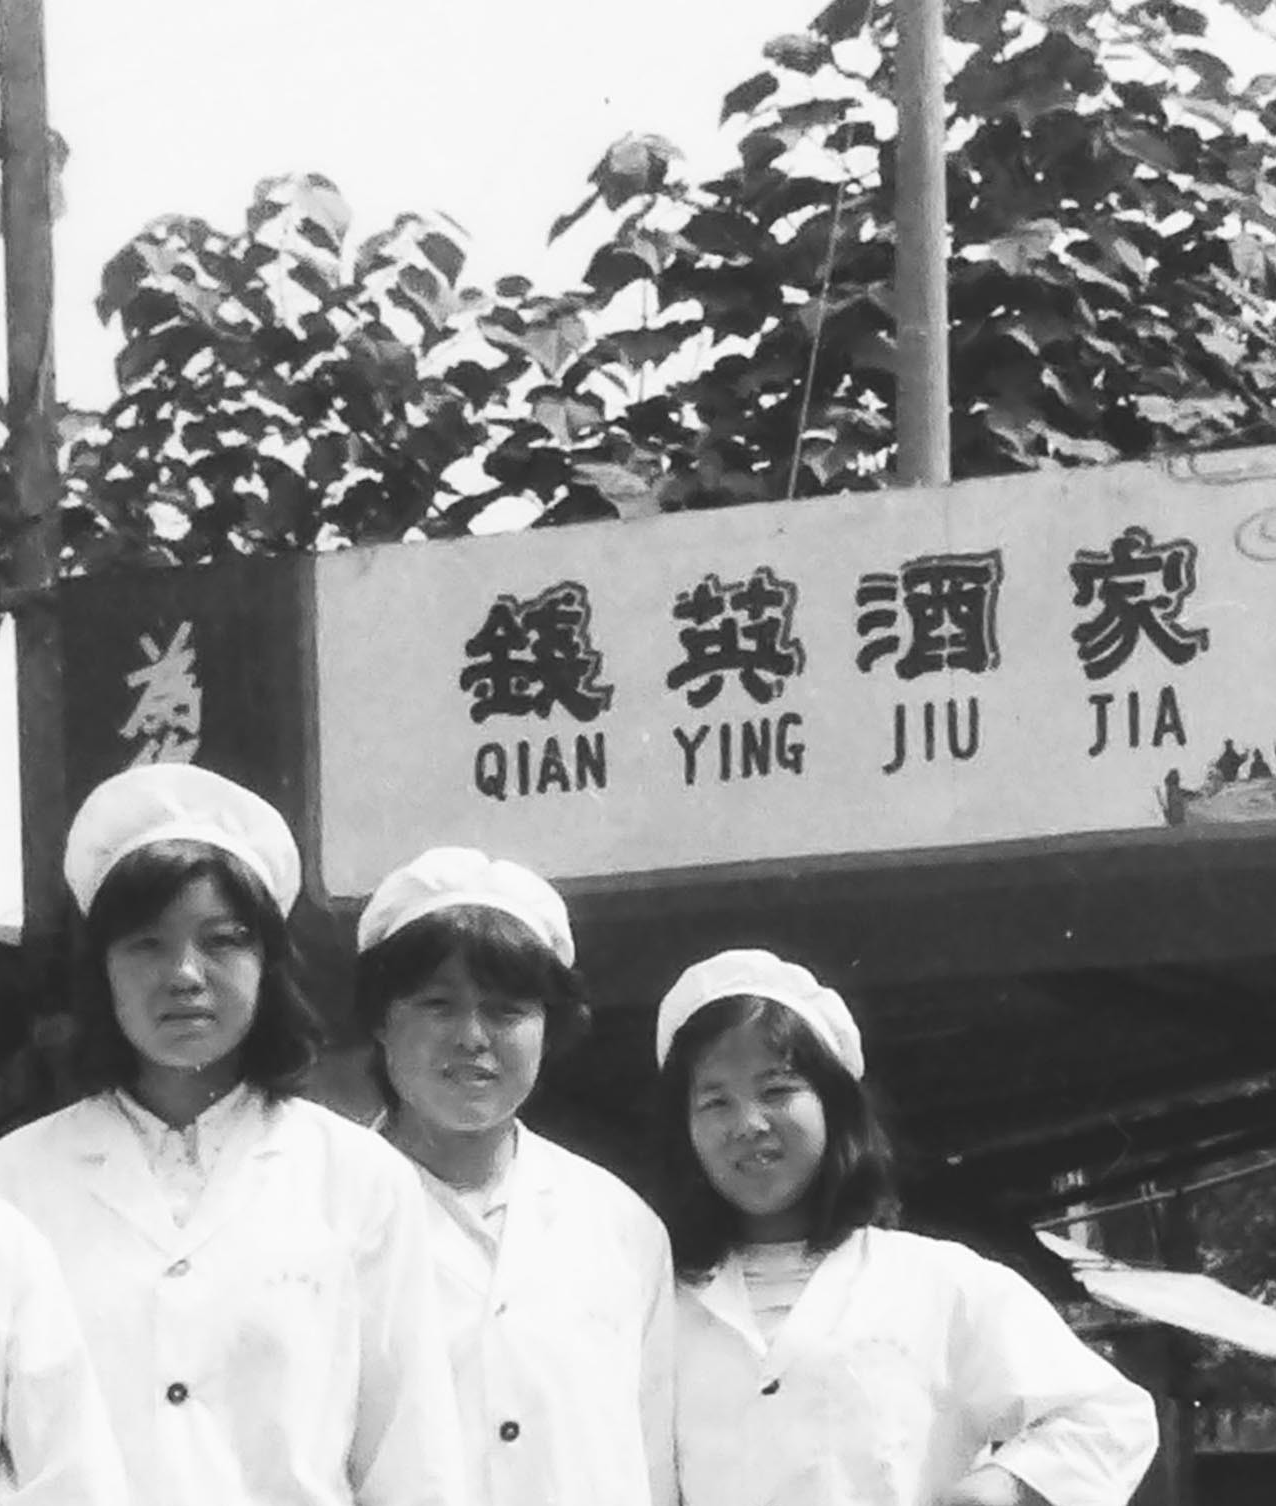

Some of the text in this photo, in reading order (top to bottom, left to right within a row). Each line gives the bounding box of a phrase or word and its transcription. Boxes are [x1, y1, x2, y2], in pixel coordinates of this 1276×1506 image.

[473, 686, 1187, 801] QIAN YING JIU JIA
